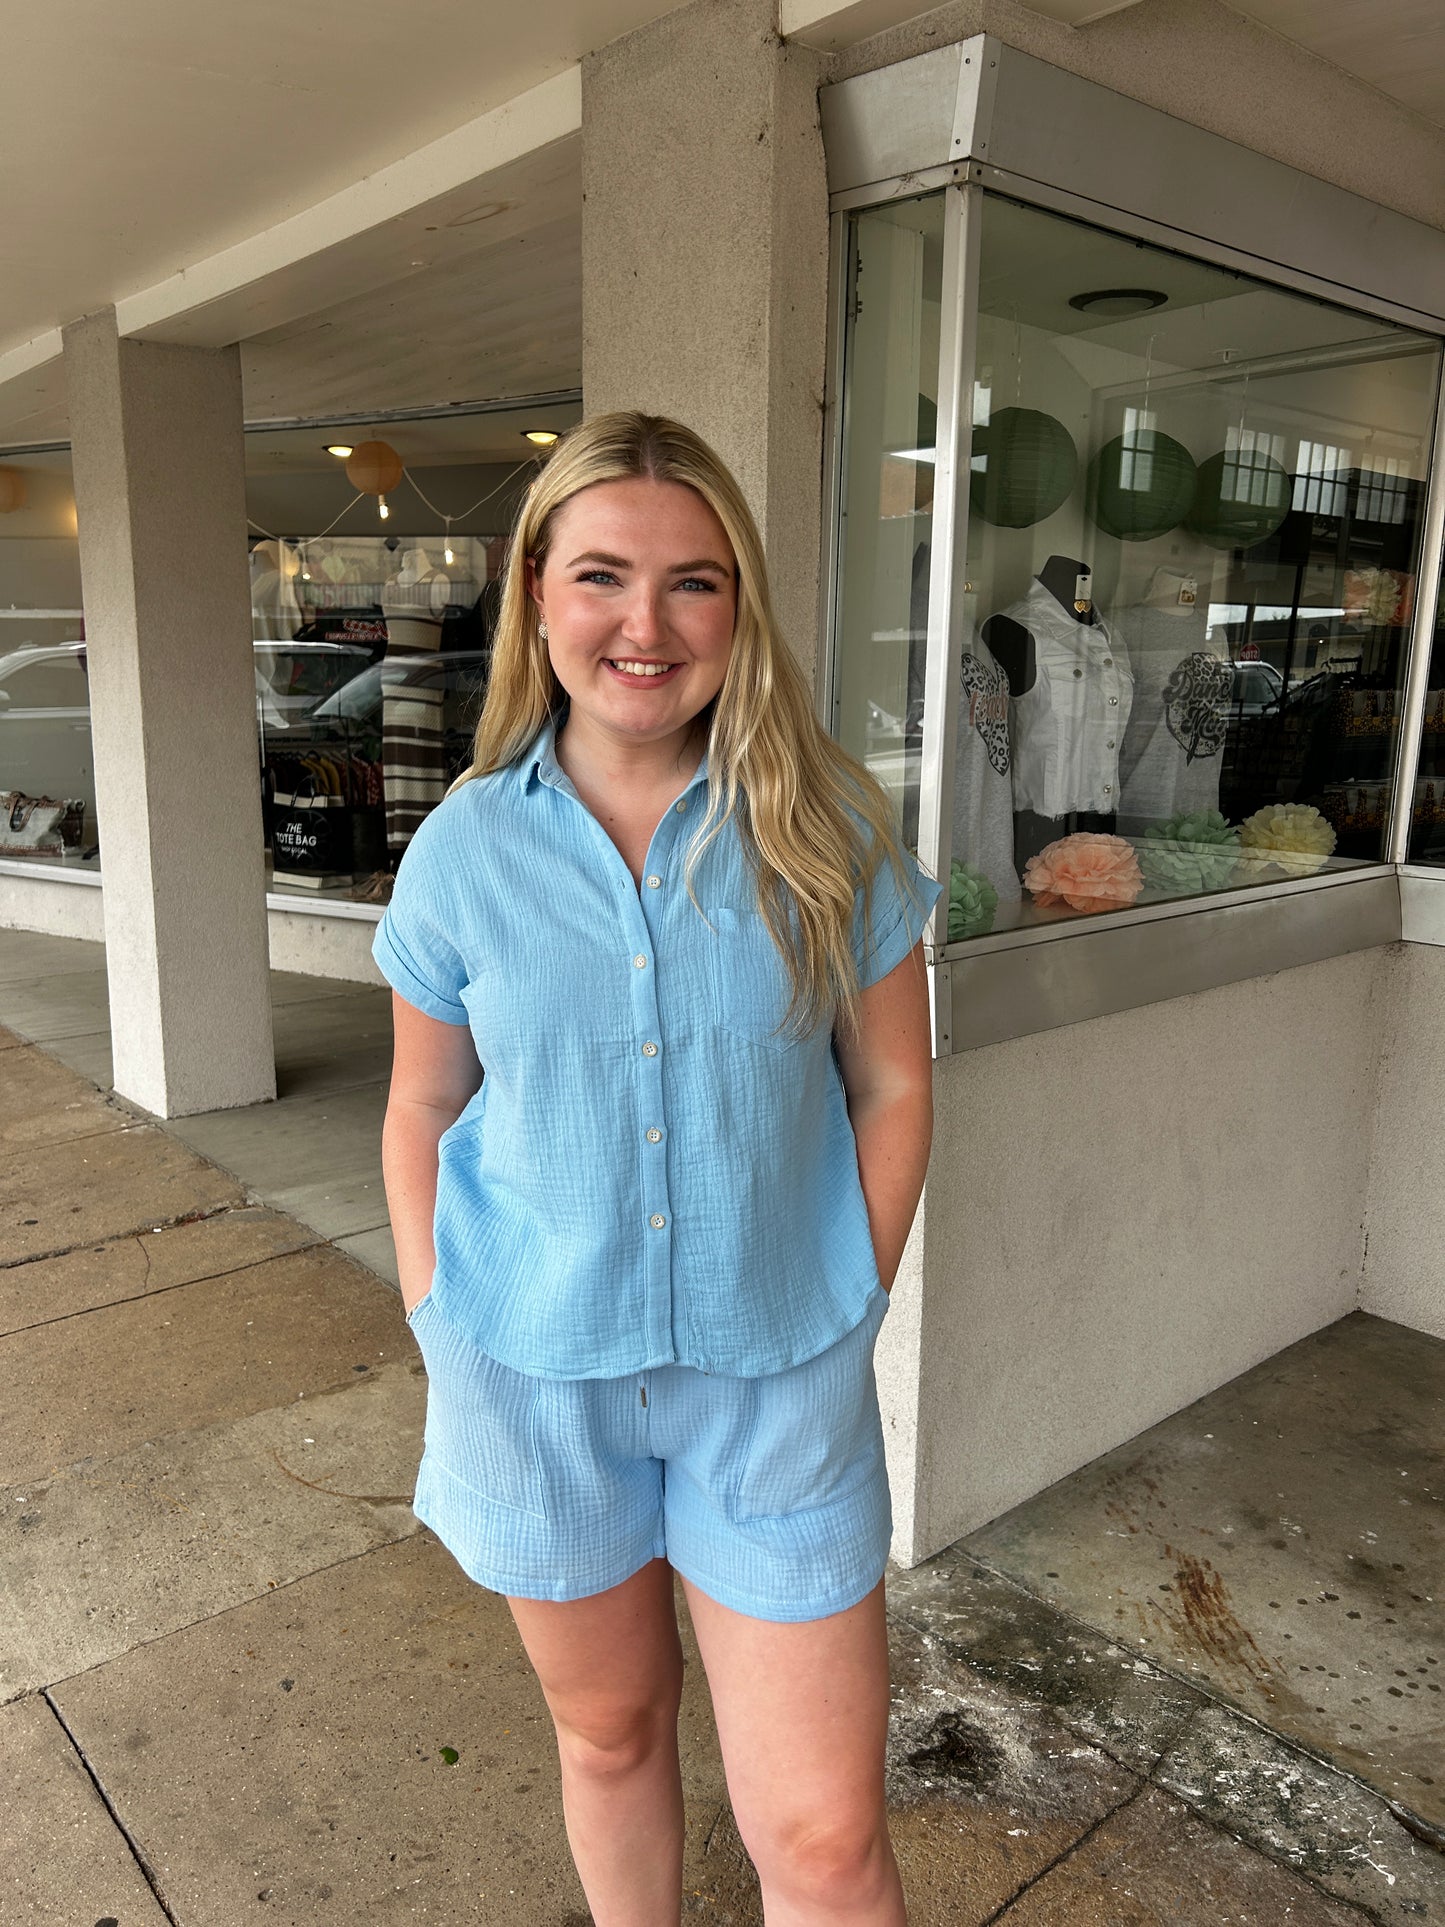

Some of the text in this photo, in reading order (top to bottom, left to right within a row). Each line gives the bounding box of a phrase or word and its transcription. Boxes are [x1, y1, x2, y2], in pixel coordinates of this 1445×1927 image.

[1162, 670, 1231, 704] Danc
[286, 822, 303, 834] THE
[275, 832, 317, 847] TOTE BAG
